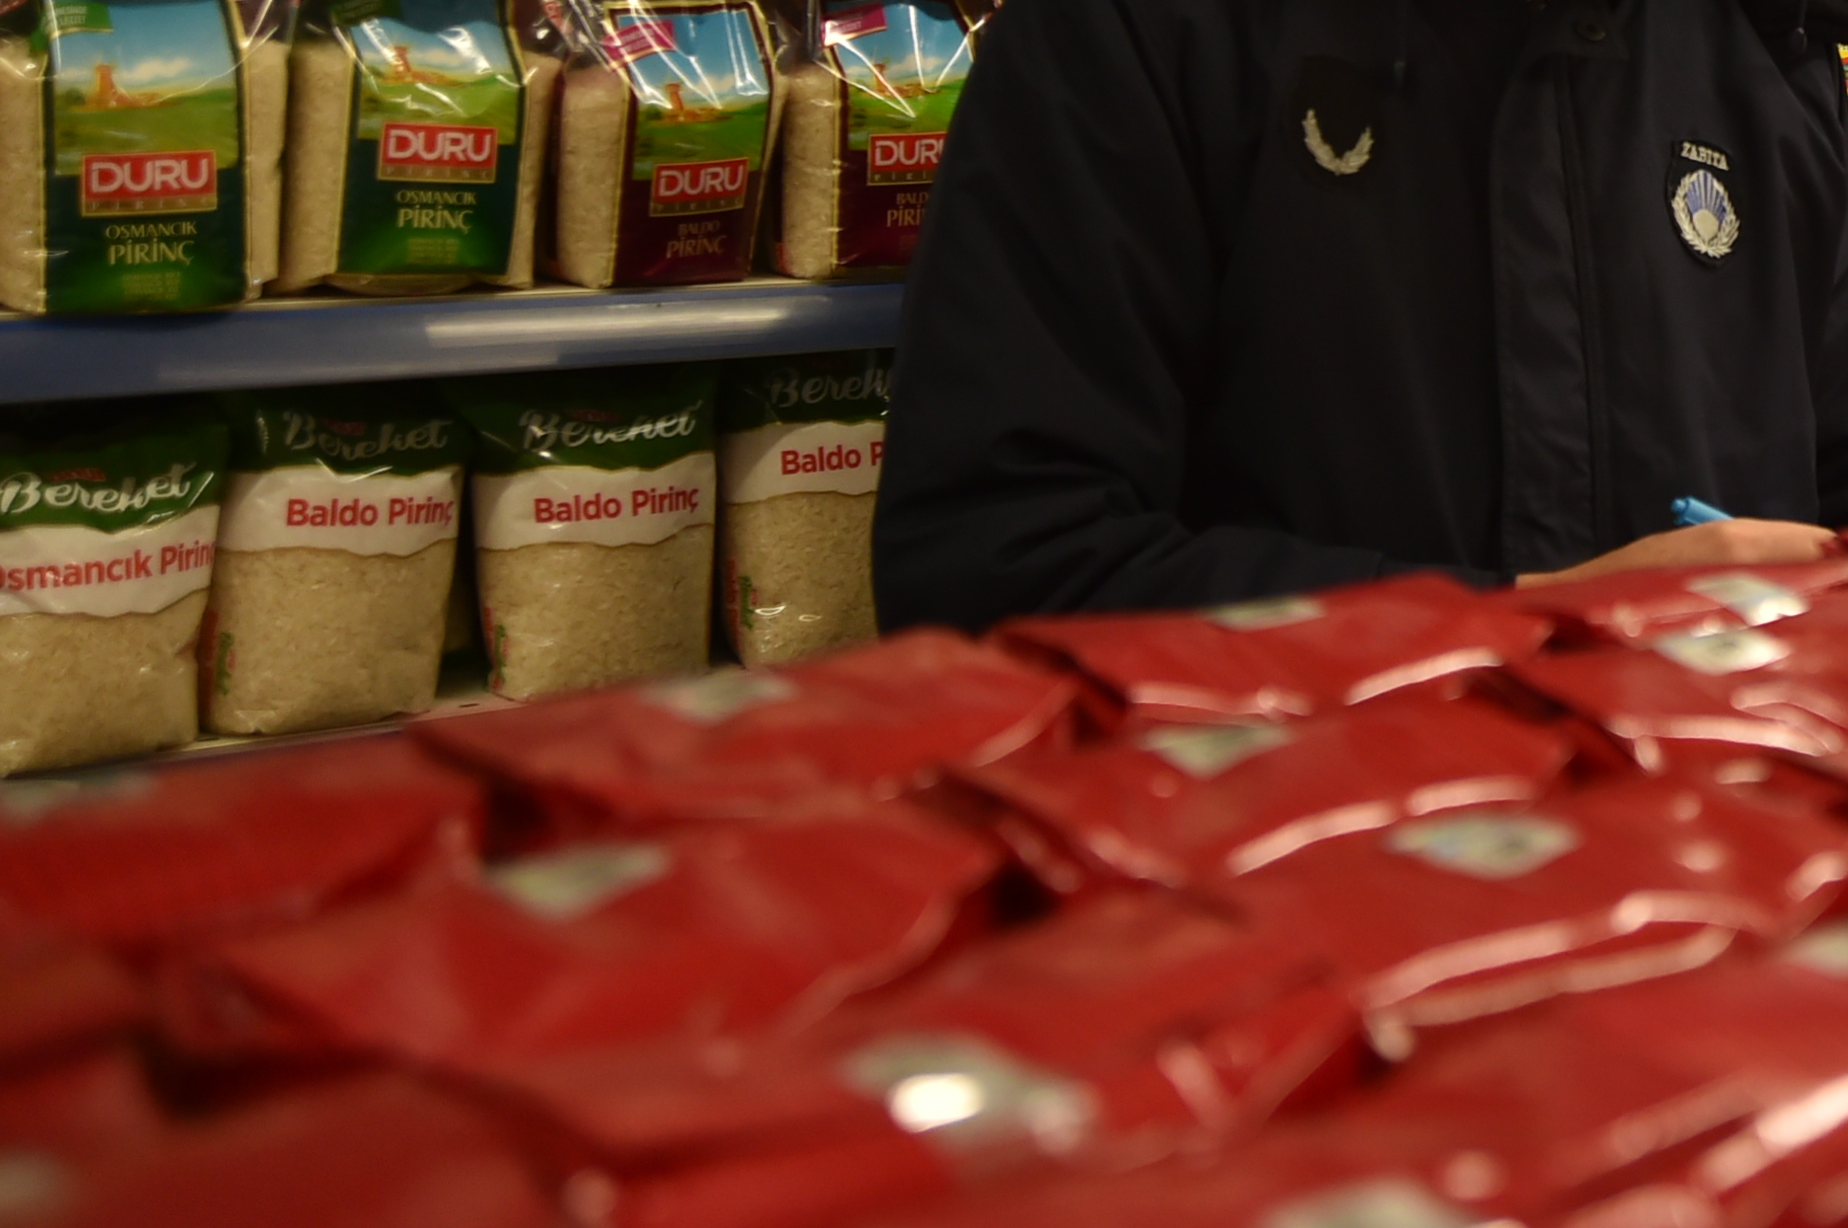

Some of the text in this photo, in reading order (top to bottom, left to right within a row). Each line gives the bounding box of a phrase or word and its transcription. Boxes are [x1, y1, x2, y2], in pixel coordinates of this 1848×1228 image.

[387, 128, 492, 162] DURU
[1680, 141, 1730, 171] ZABITA
[90, 159, 210, 194] DURU
[657, 164, 744, 198] DURU
[396, 189, 477, 206] OSMANCIK
[896, 192, 929, 206] BALD
[105, 221, 198, 240] OSMANCIK
[397, 207, 472, 233] PİRİNÇ
[886, 206, 925, 228] PİRİ
[109, 240, 194, 266] PİRİNÇ
[284, 412, 454, 462] Bereket
[781, 445, 861, 475] Baldo
[286, 498, 456, 527] Baldo Pirinç
[534, 486, 699, 524] Baldo Pirinç
